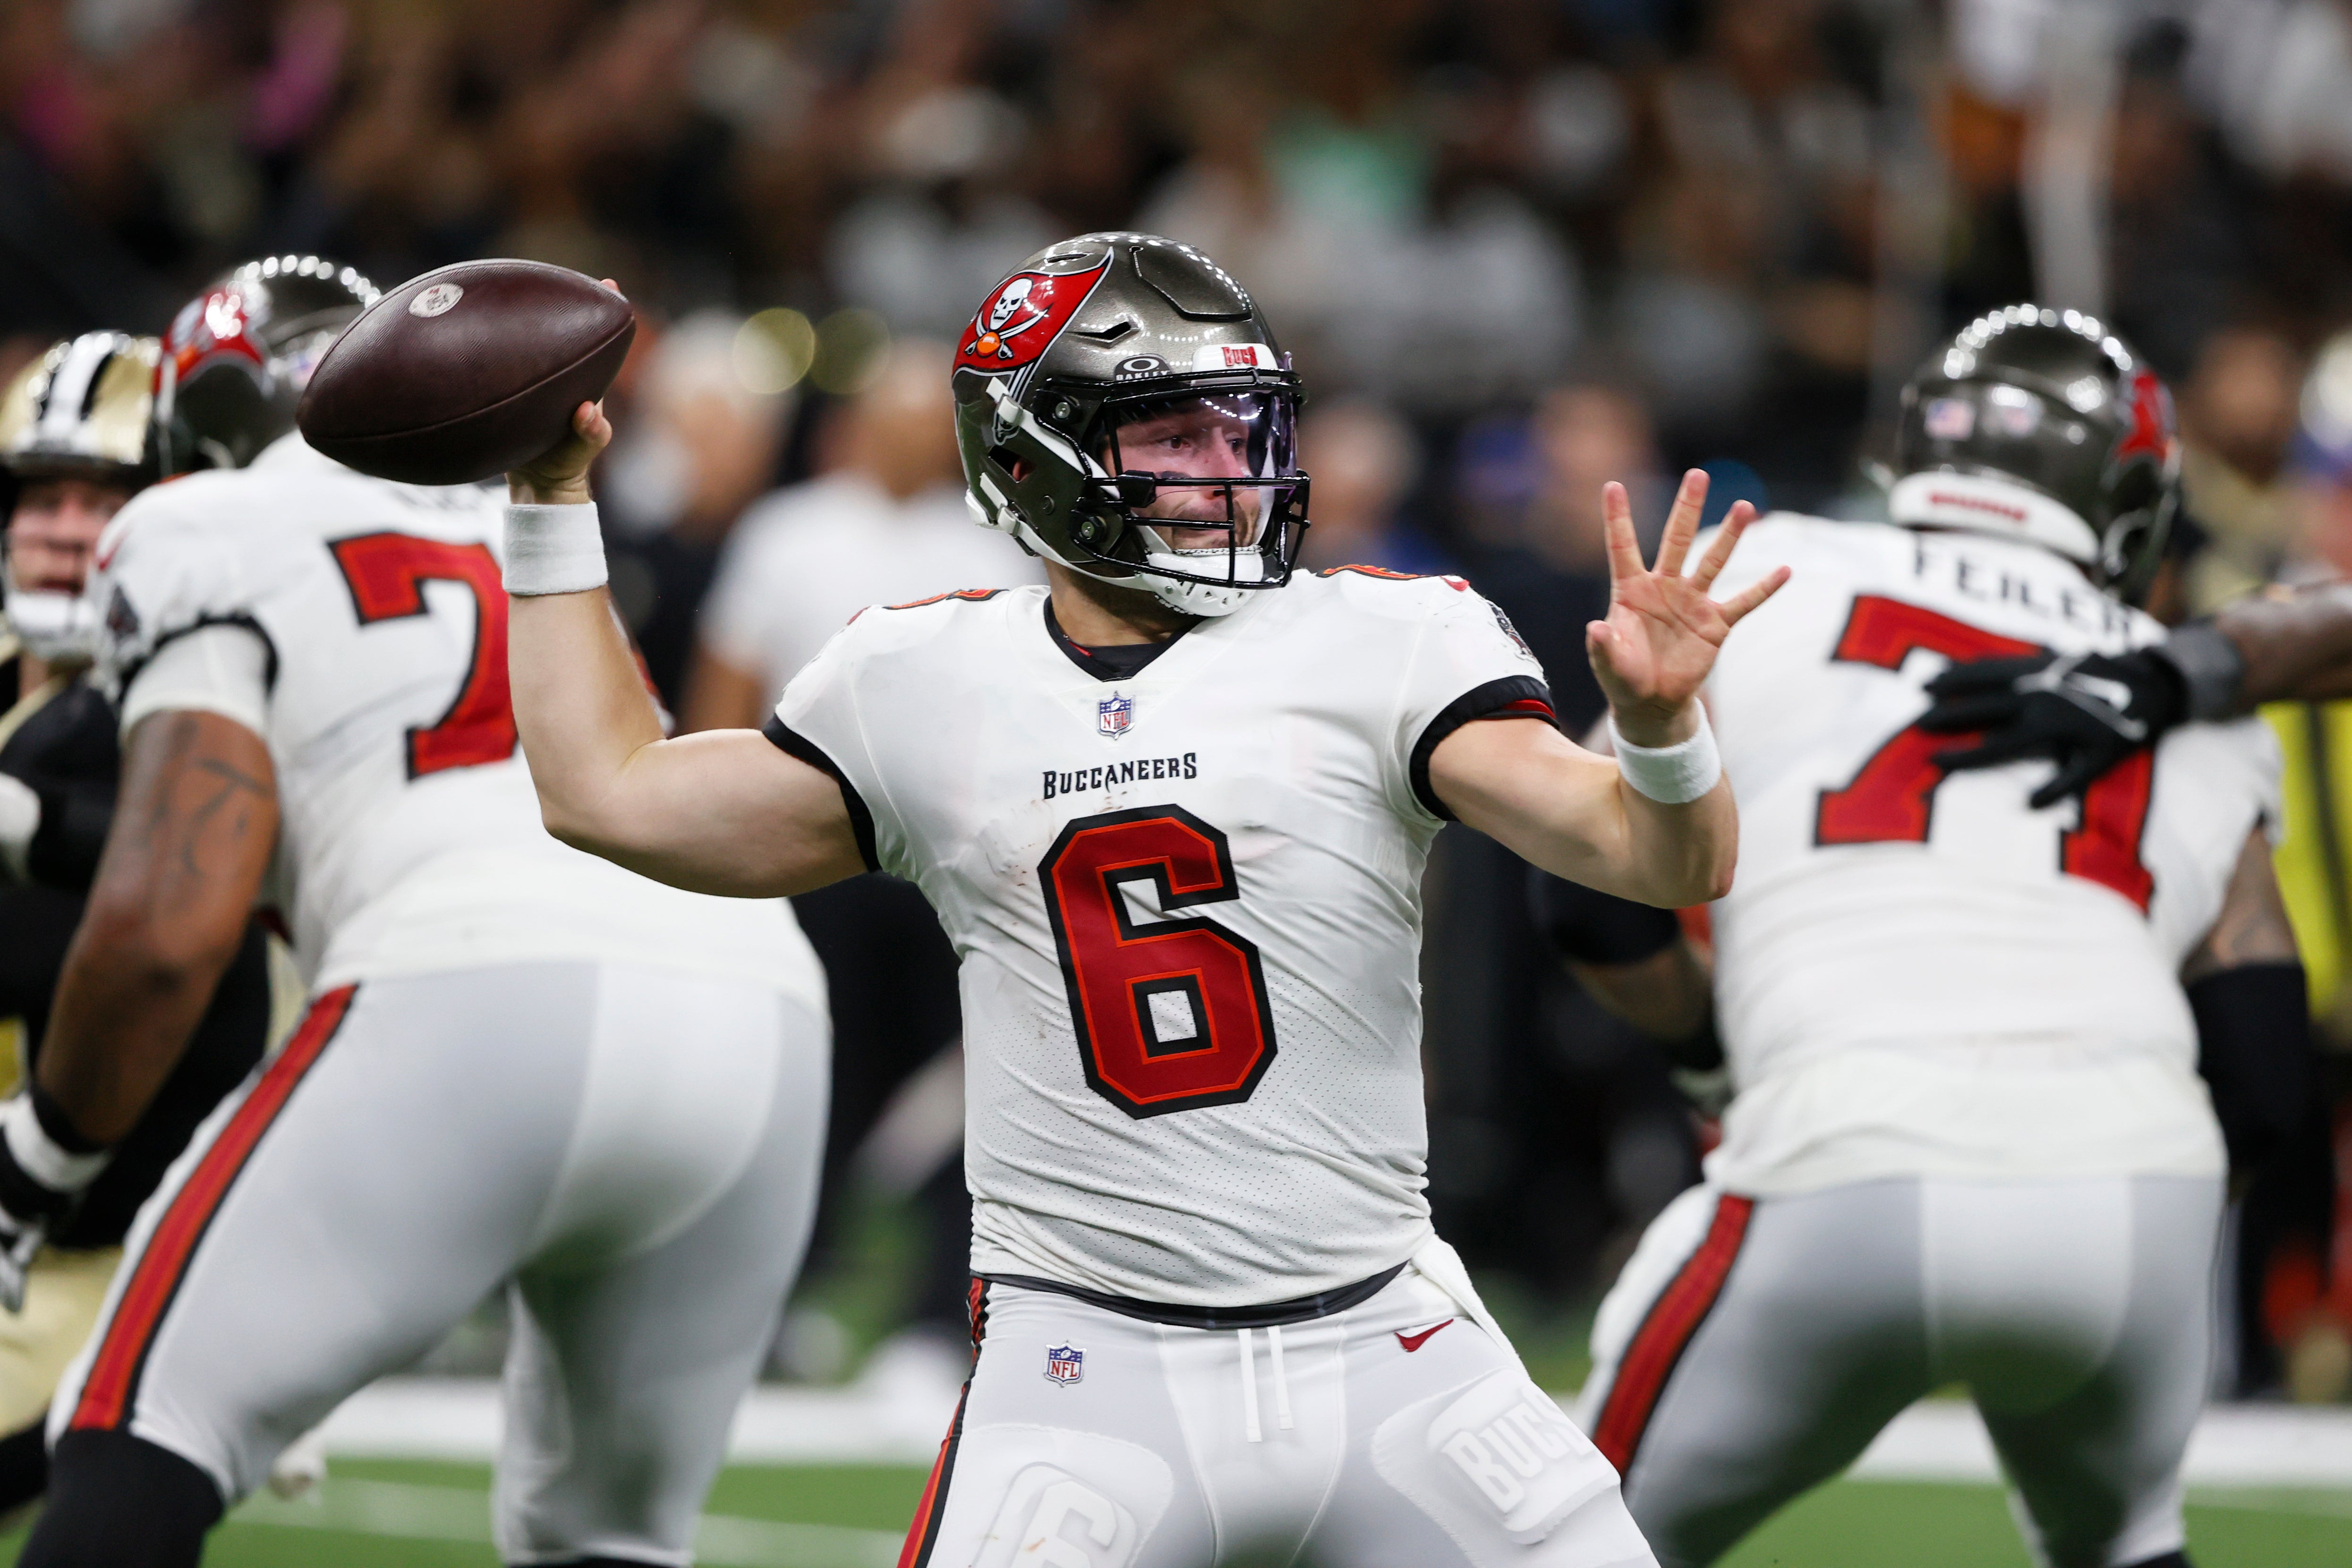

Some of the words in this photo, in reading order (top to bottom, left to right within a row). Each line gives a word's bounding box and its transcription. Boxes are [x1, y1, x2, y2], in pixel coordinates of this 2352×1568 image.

[1222, 346, 1258, 366] BUCS
[1103, 711, 1129, 729] NFL
[1042, 752, 1197, 799] BUCCANEERS
[1036, 803, 1278, 1120] 6
[1050, 1360, 1078, 1378] NFL
[1440, 1384, 1597, 1514] BUCS
